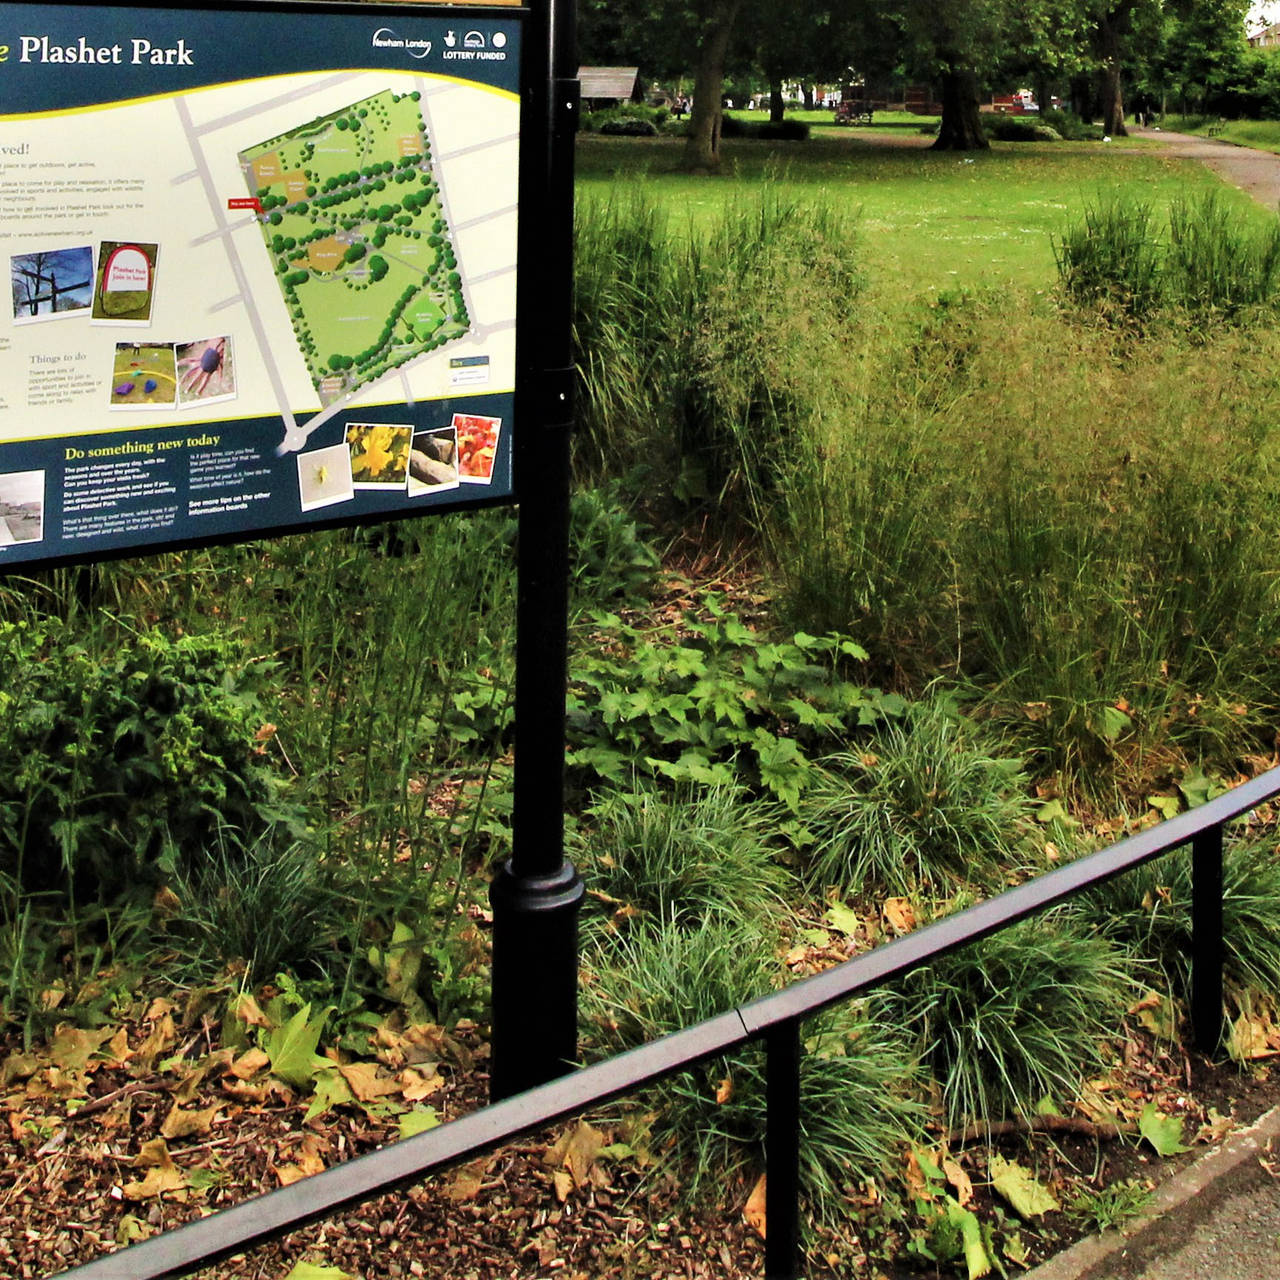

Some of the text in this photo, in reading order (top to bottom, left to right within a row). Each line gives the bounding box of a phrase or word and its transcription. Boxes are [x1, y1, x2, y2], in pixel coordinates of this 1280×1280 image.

[373, 39, 431, 47] Newham London
[19, 36, 122, 66] Plashet
[131, 38, 194, 66] Park
[443, 51, 506, 60] LOTTERY FUNDED
[29, 355, 61, 364] Things
[75, 352, 86, 360] do
[65, 434, 220, 460] Do something new today
[189, 500, 201, 508] See
[220, 496, 232, 505] tips
[242, 494, 253, 502] the
[254, 492, 271, 500] other
[188, 503, 248, 516] information boards
